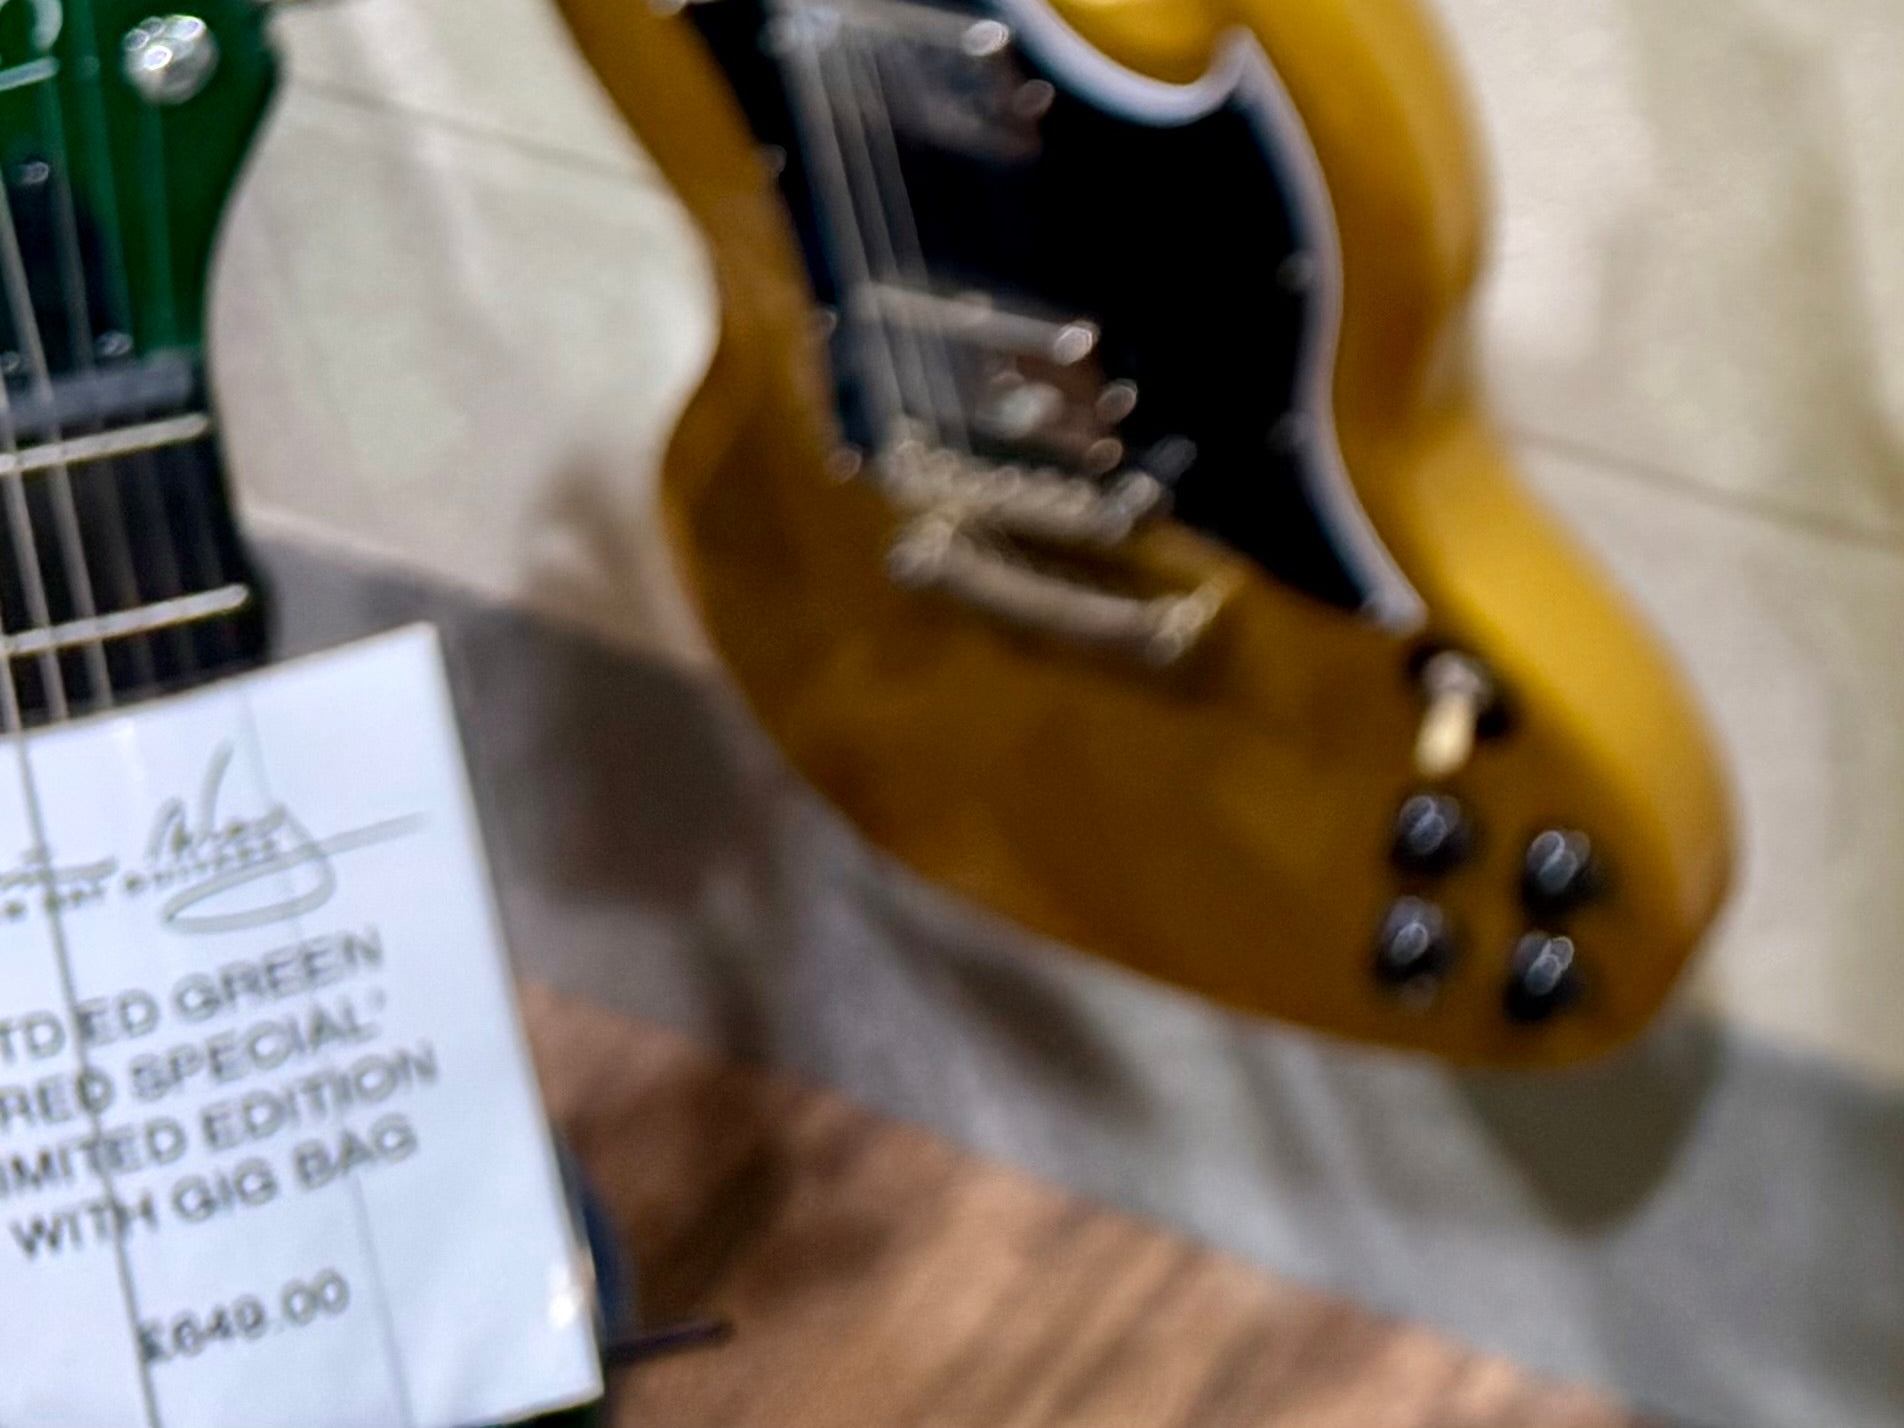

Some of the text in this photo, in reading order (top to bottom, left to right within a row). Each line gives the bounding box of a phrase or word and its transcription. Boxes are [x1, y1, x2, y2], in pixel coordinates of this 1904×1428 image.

[0, 1010, 66, 1063] TD
[170, 926, 386, 1023] GREEN
[0, 1040, 440, 1200] IMITED EDITION
[11, 1112, 419, 1259] WITH GIG BAG
